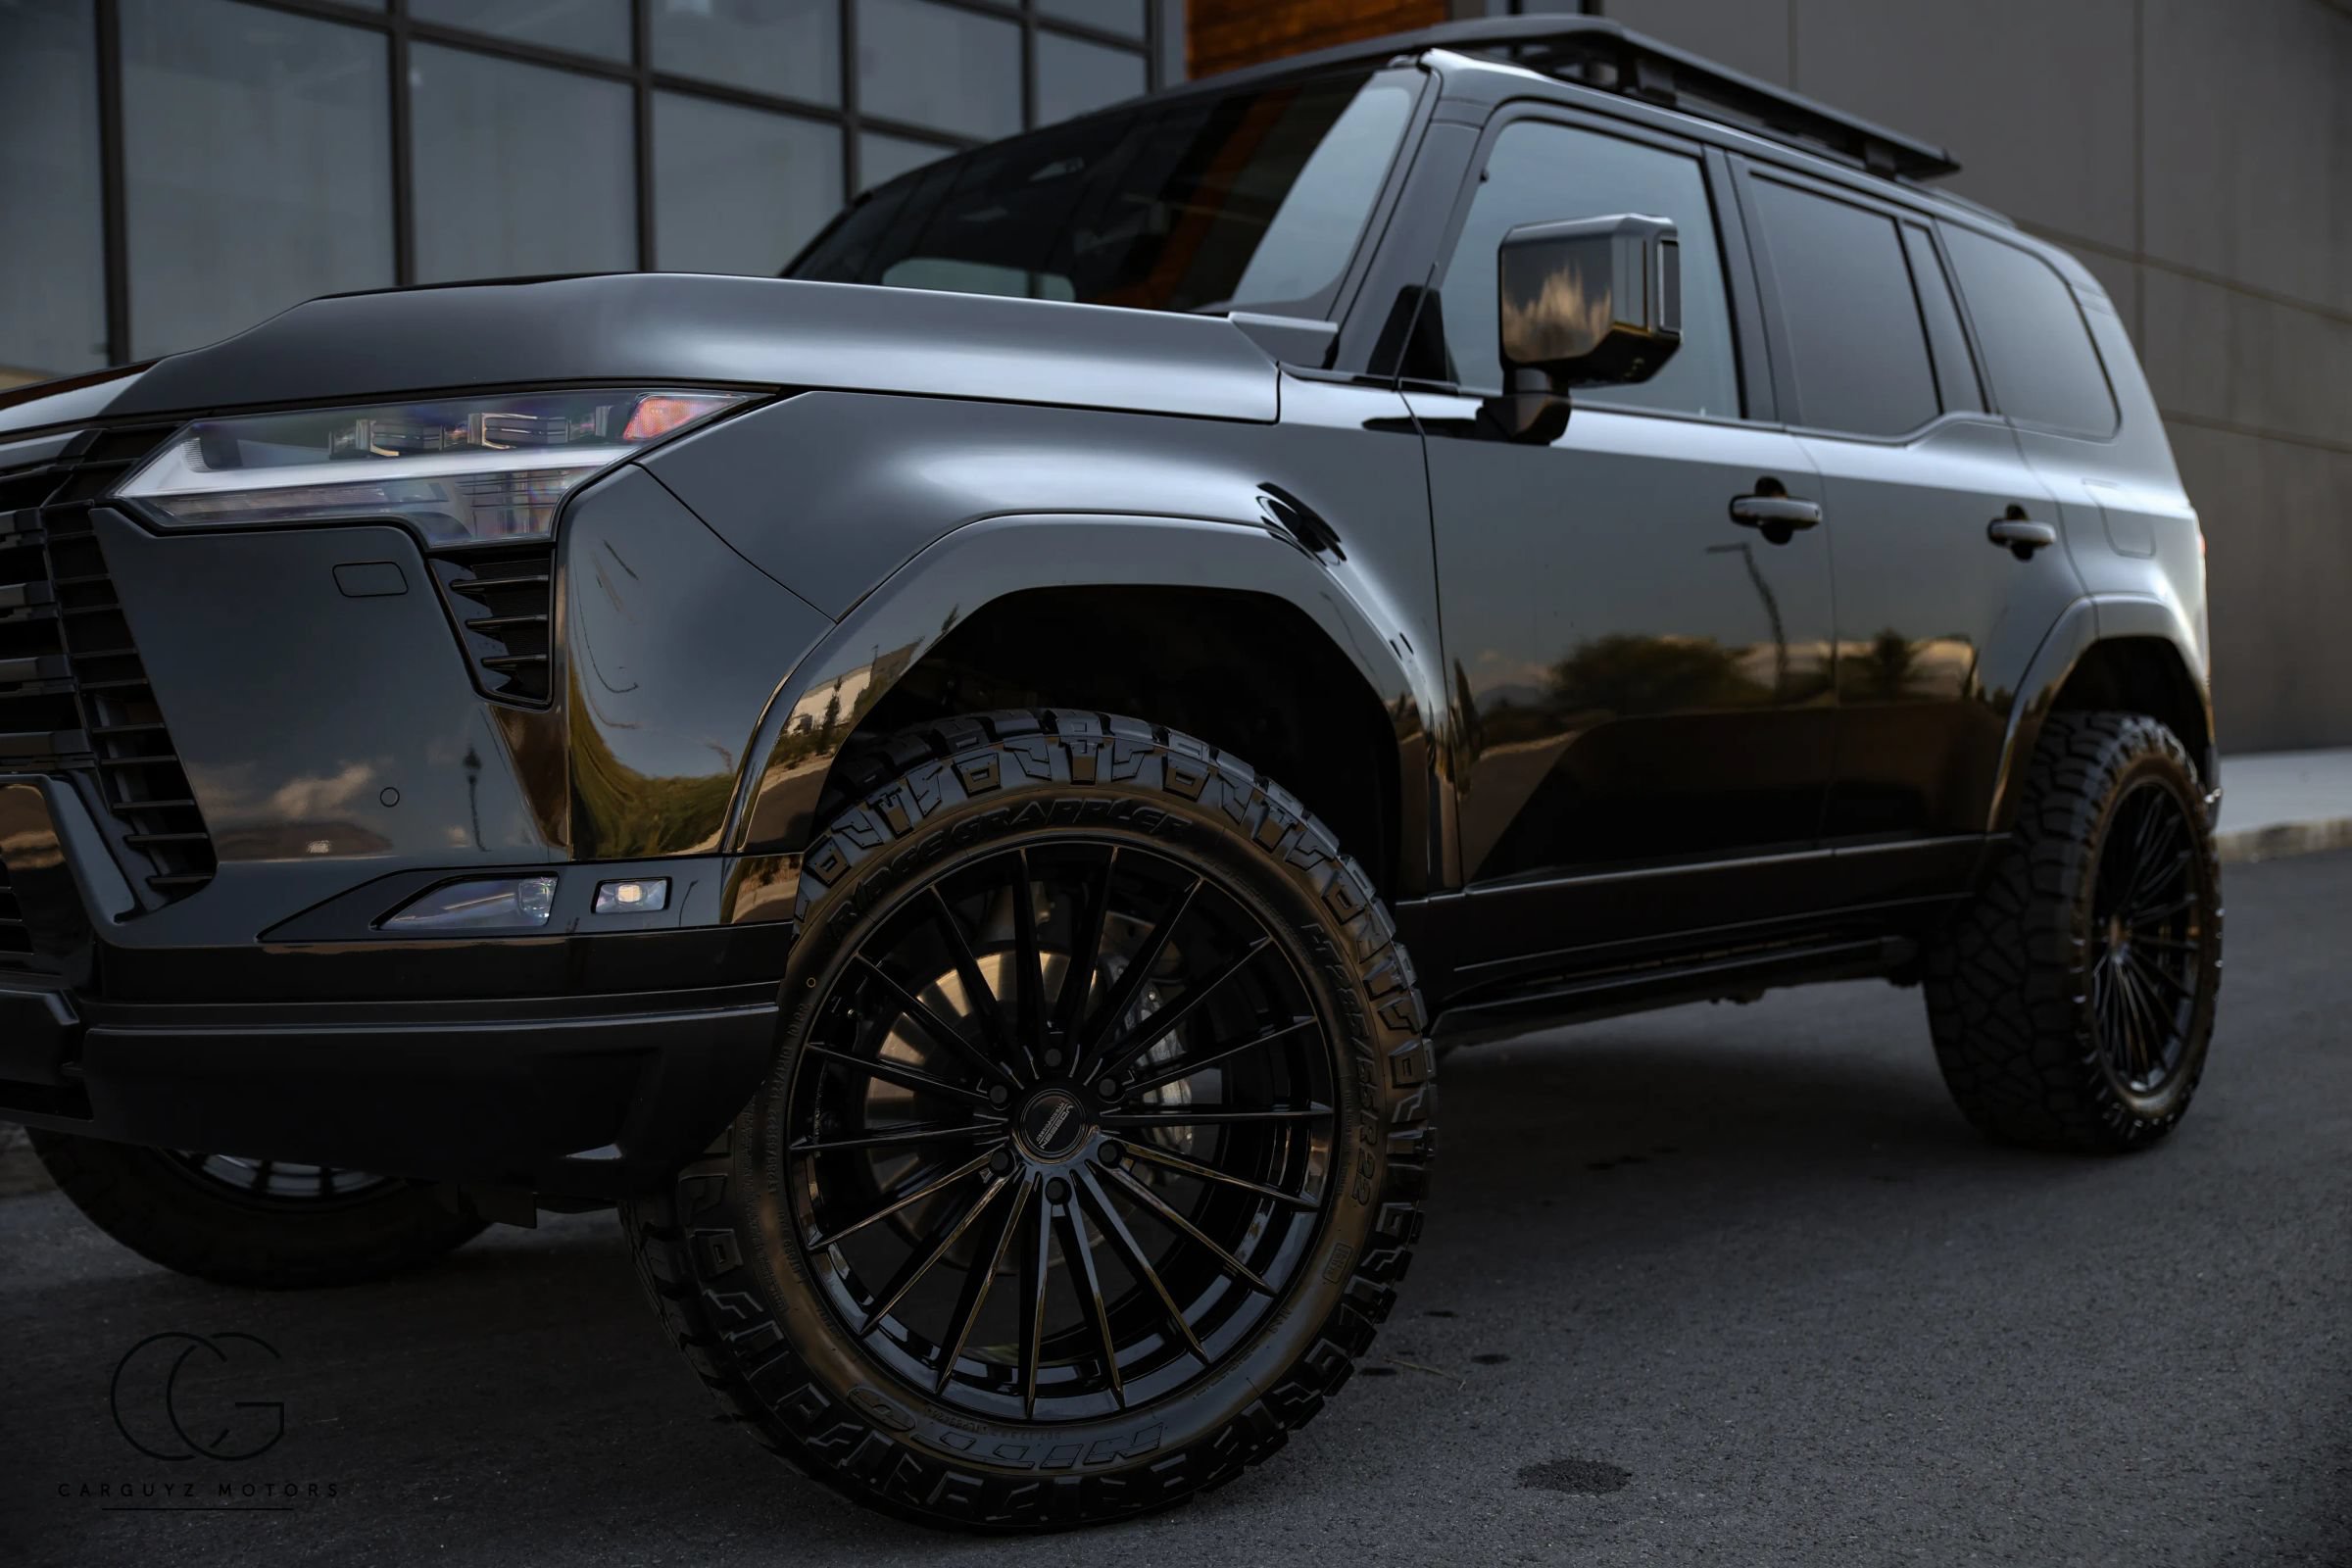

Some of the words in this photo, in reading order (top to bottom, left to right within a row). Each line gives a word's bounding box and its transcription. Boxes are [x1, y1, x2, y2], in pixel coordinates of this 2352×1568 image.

[823, 831, 947, 939] RIDGE
[951, 798, 1192, 844] GRAPPLER
[847, 1387, 1165, 1470] NITTO
